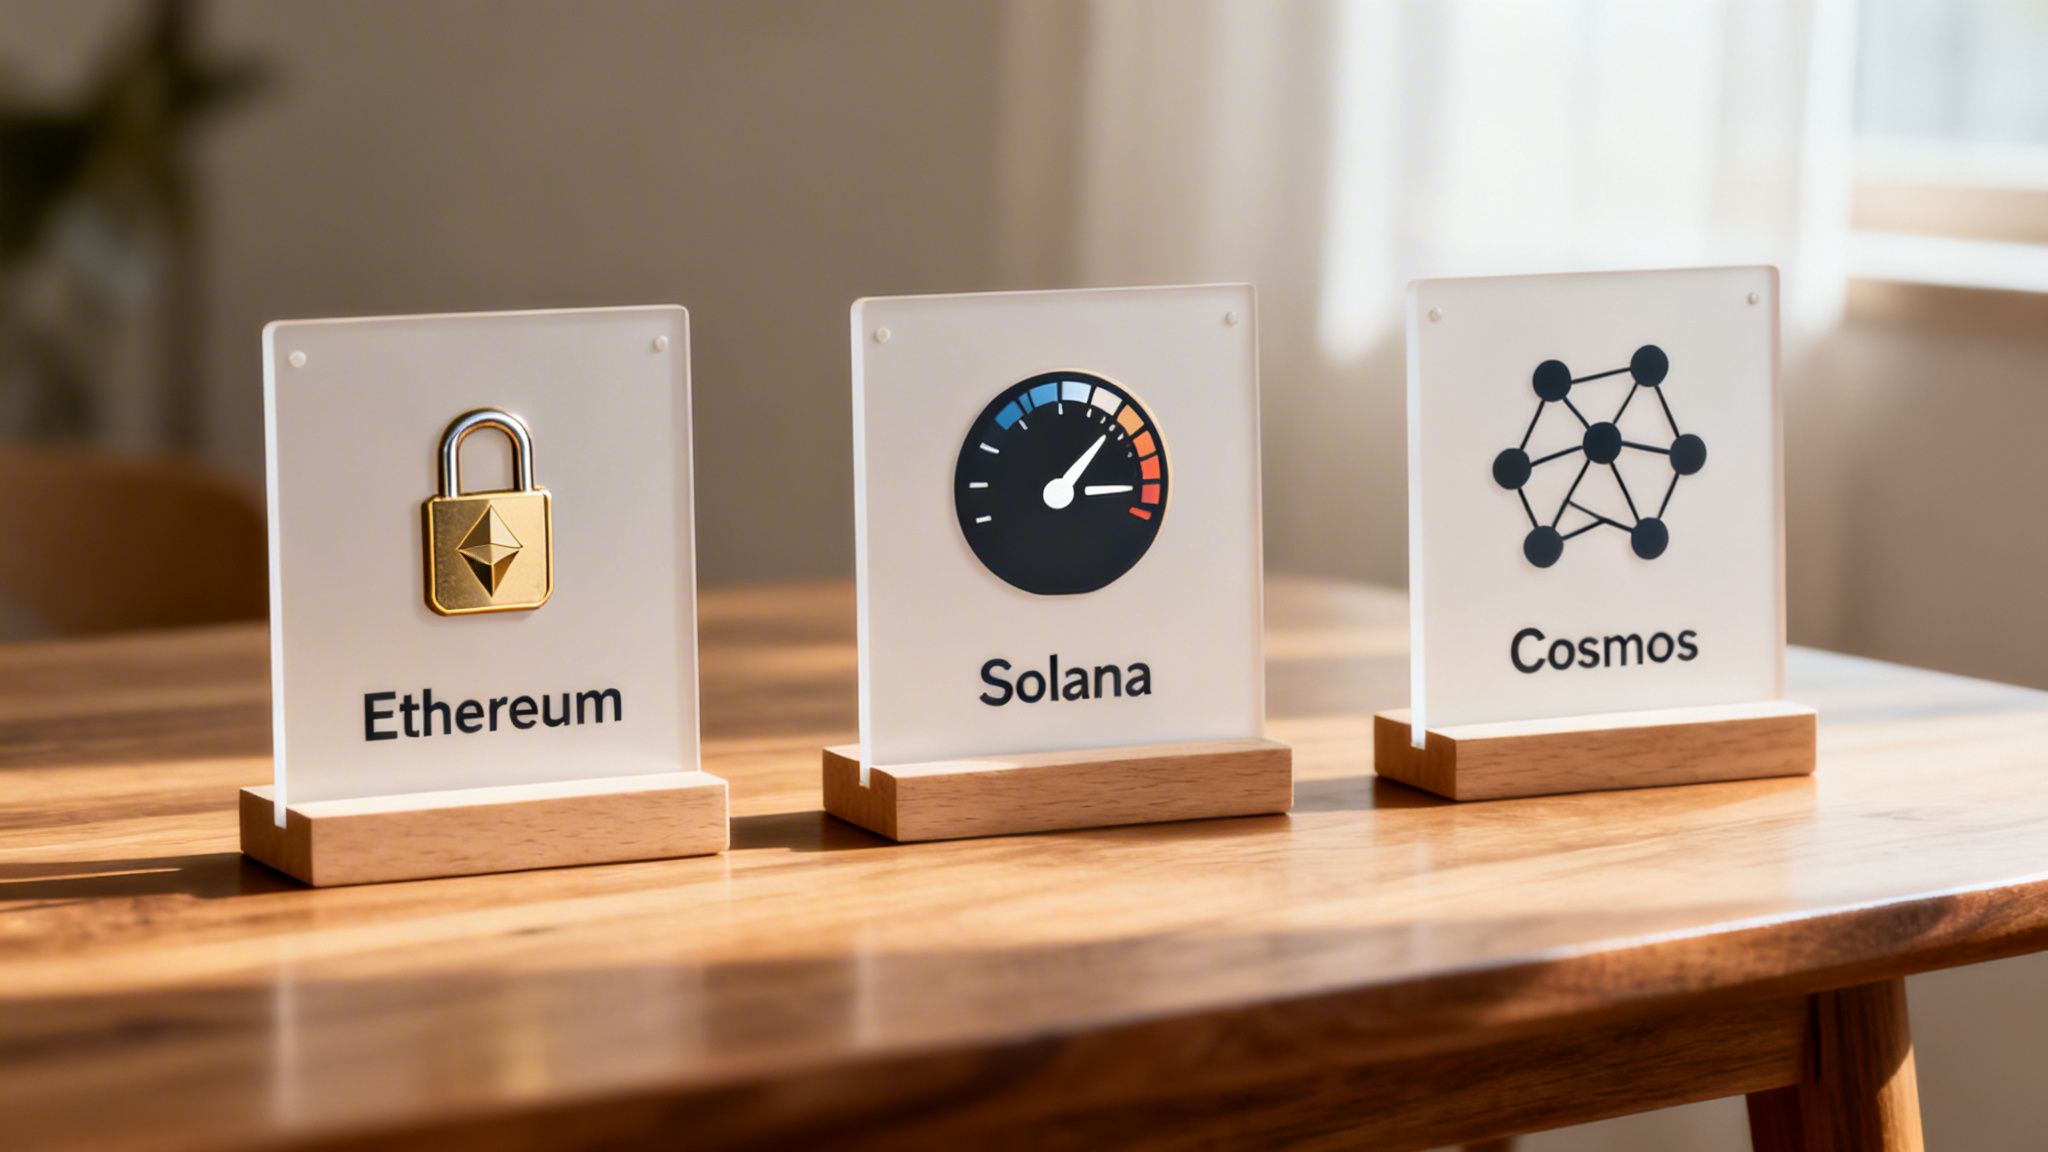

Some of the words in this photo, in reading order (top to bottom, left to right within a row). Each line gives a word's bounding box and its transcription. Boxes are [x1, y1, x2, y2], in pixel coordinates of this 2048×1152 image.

[1510, 627, 1699, 674] Cosmos
[979, 653, 1153, 707] Solana
[364, 687, 623, 742] Ethereum
